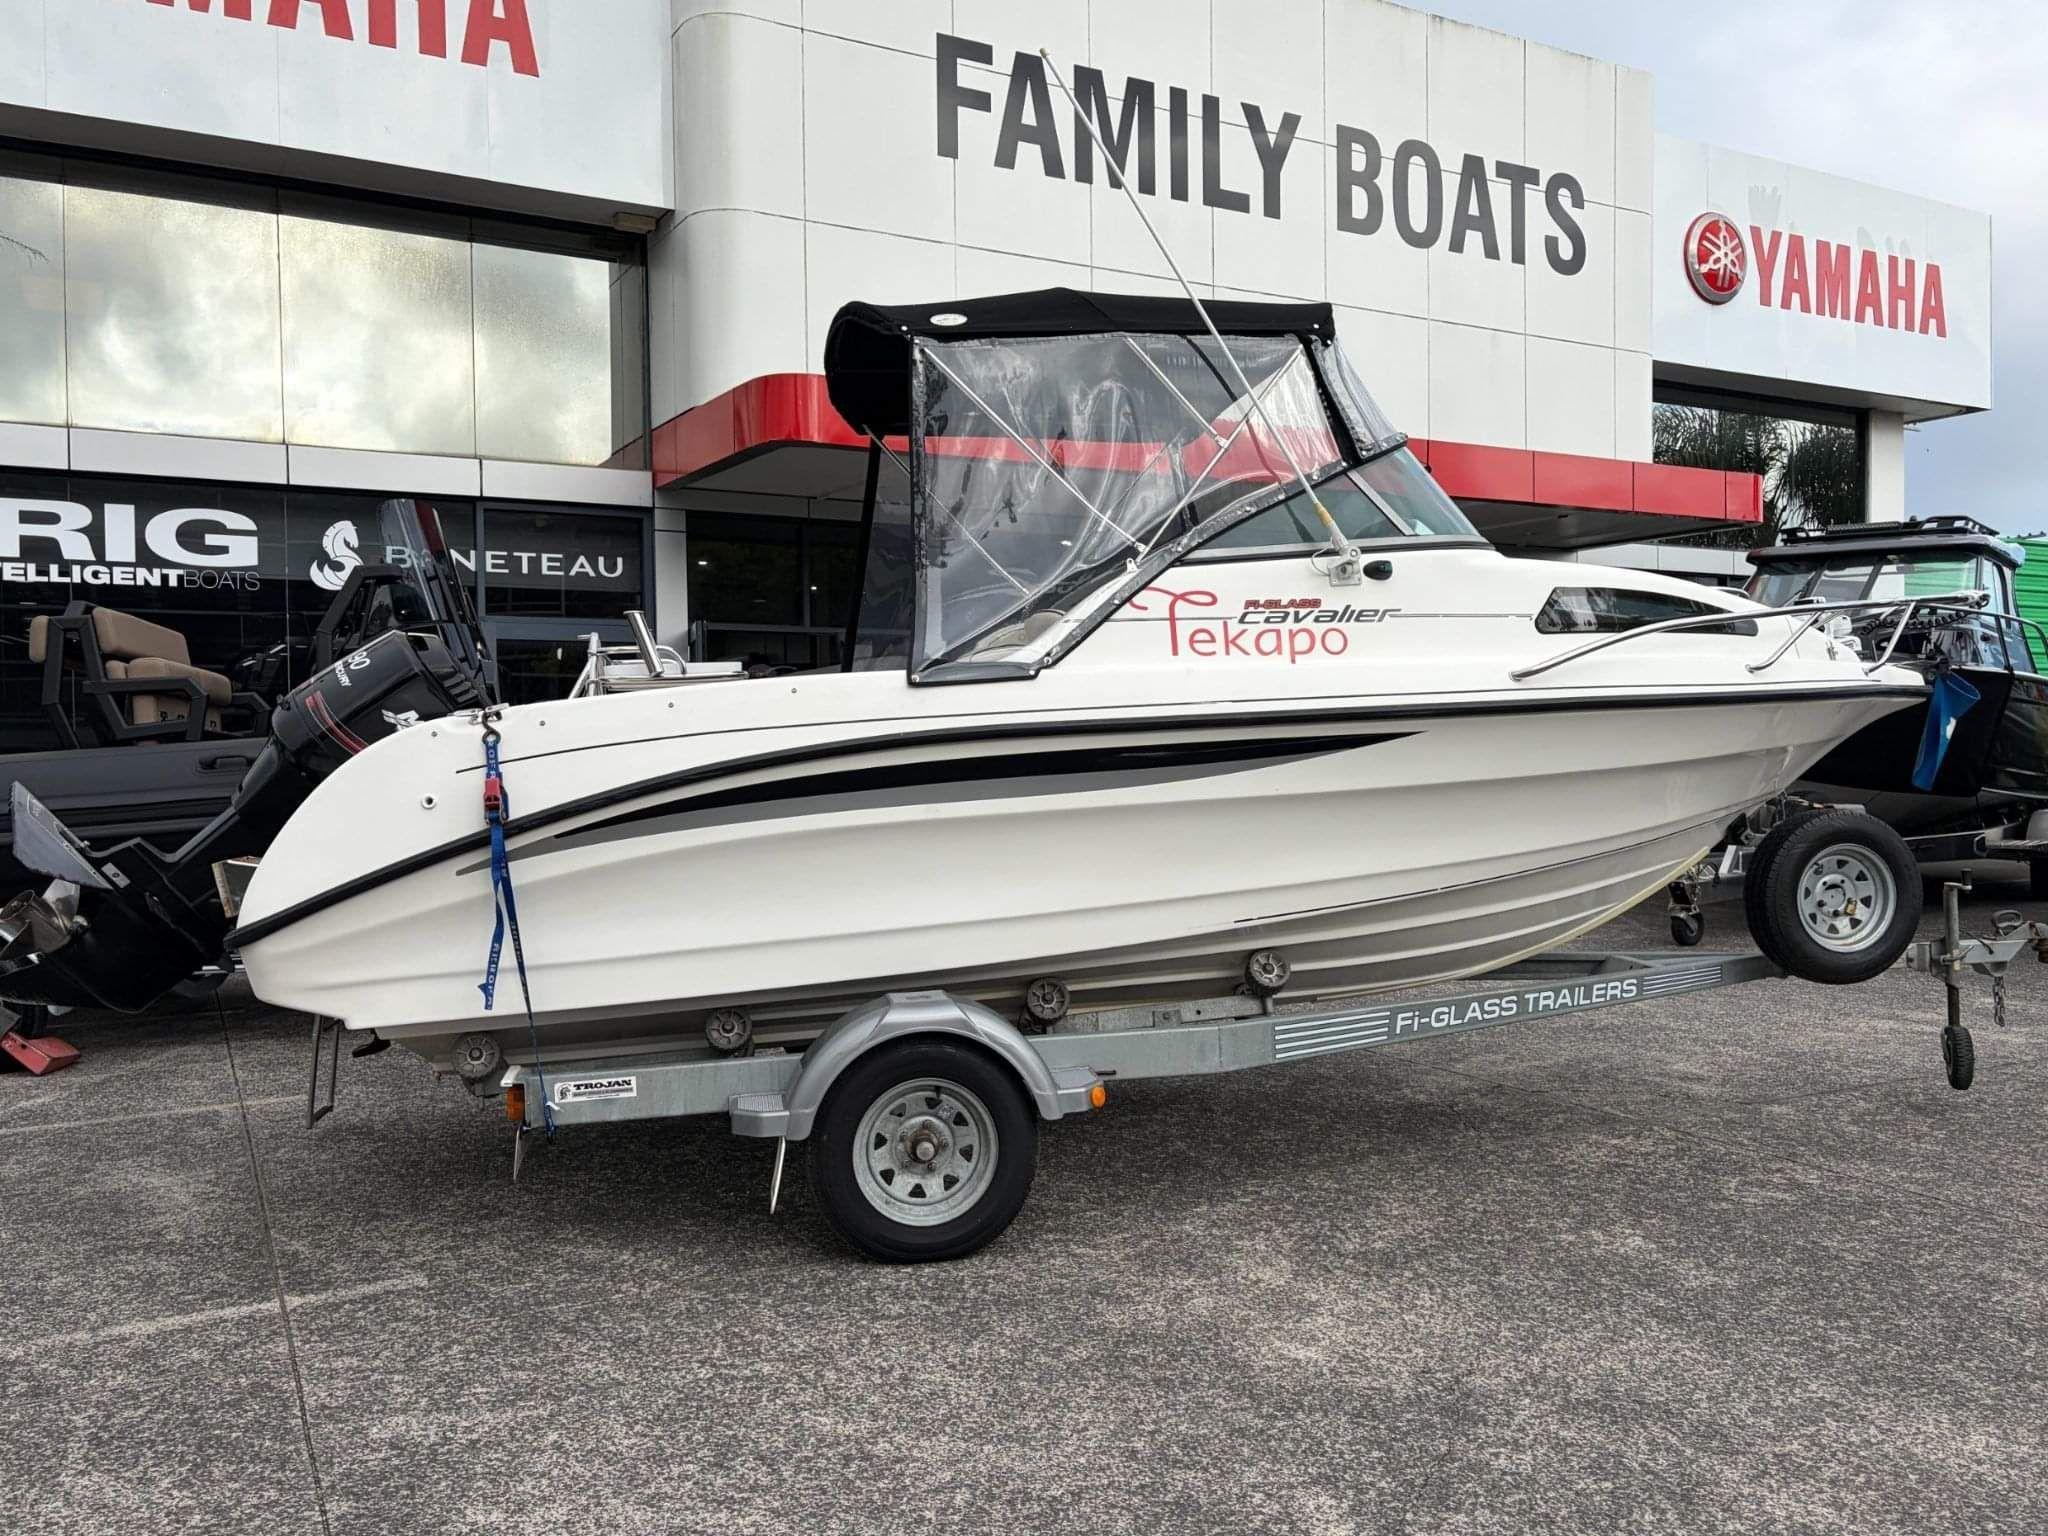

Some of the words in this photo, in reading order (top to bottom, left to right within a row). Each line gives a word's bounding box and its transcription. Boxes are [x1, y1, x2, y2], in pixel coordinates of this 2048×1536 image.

[936, 33, 1301, 219] FAMILY
[1336, 124, 1586, 275] BOATS
[1749, 225, 1947, 338] YAMAHA
[385, 545, 624, 578] BNETEAU
[1129, 588, 1348, 664] Tekapo
[1524, 979, 1638, 1013] TRAILERS
[573, 1079, 632, 1091] TROJAN
